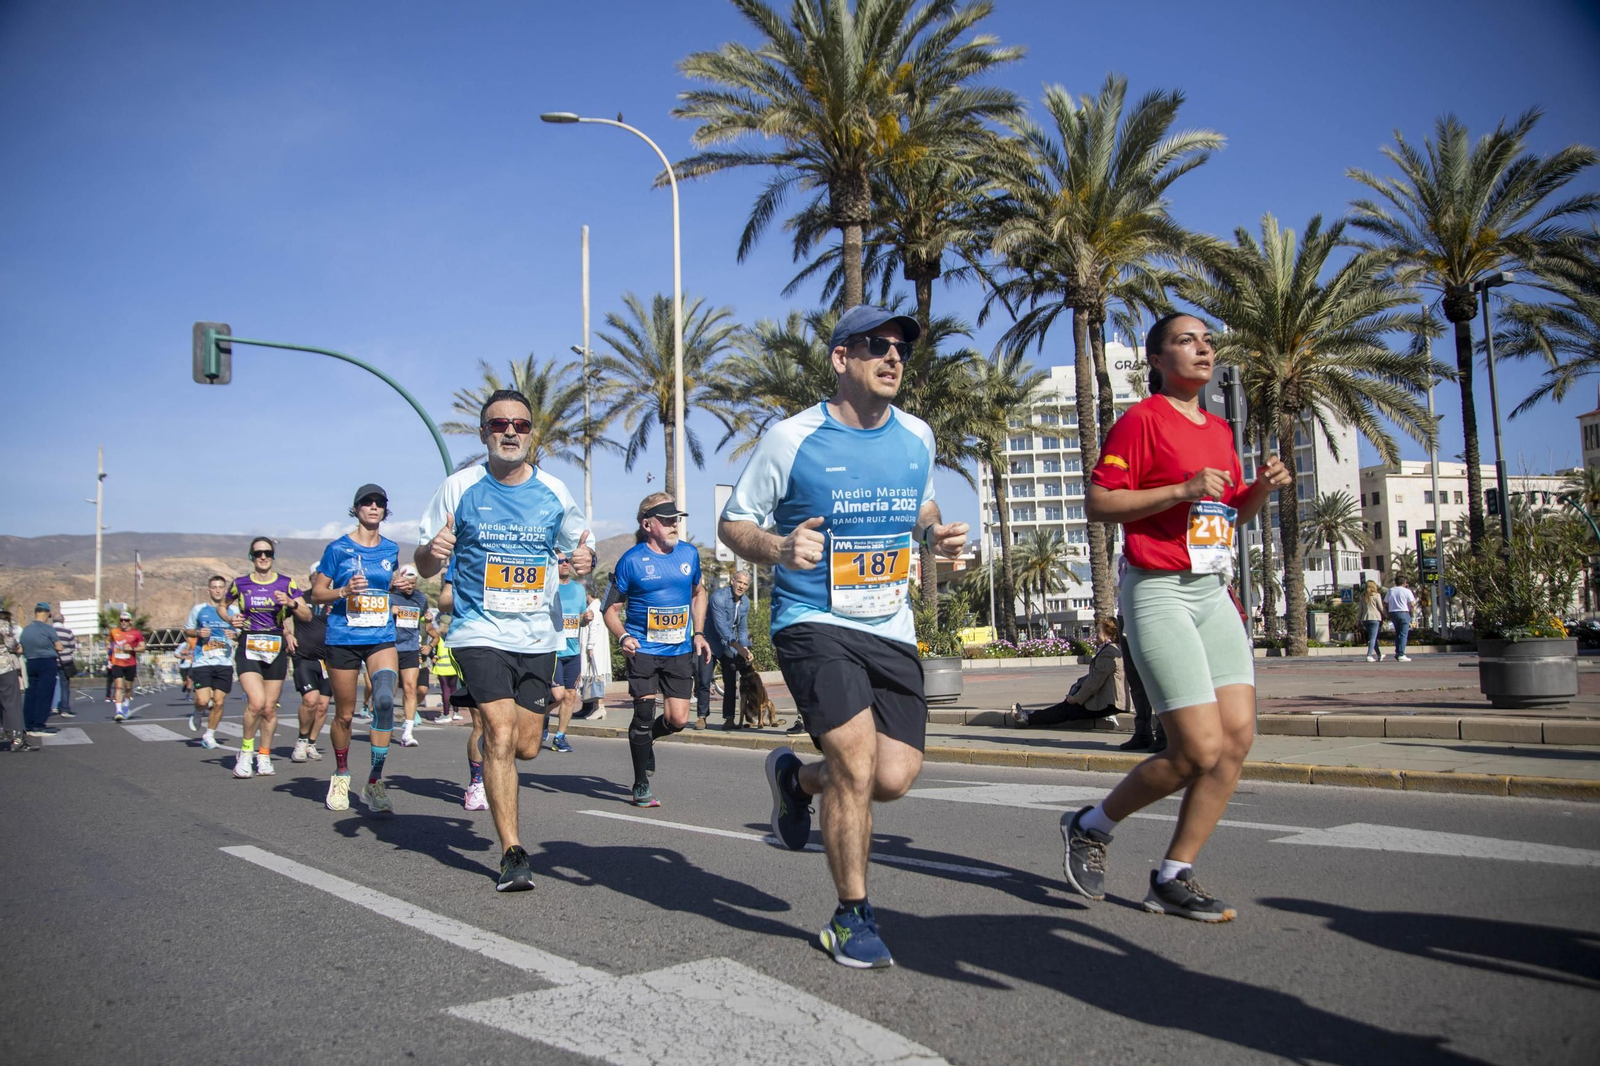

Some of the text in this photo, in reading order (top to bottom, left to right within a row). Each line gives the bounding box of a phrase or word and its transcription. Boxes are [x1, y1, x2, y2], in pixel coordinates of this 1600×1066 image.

[831, 487, 918, 500] Medio Maratón
[832, 498, 917, 514] Almería 2025
[832, 516, 864, 525] RAMÓN
[866, 515, 887, 523] RUIZ
[478, 522, 547, 533] Medio Maratón
[478, 531, 546, 542] Almería 2025
[852, 550, 899, 577] 187
[500, 565, 537, 584] 188
[352, 595, 386, 609] 1589
[653, 613, 684, 626] 1901
